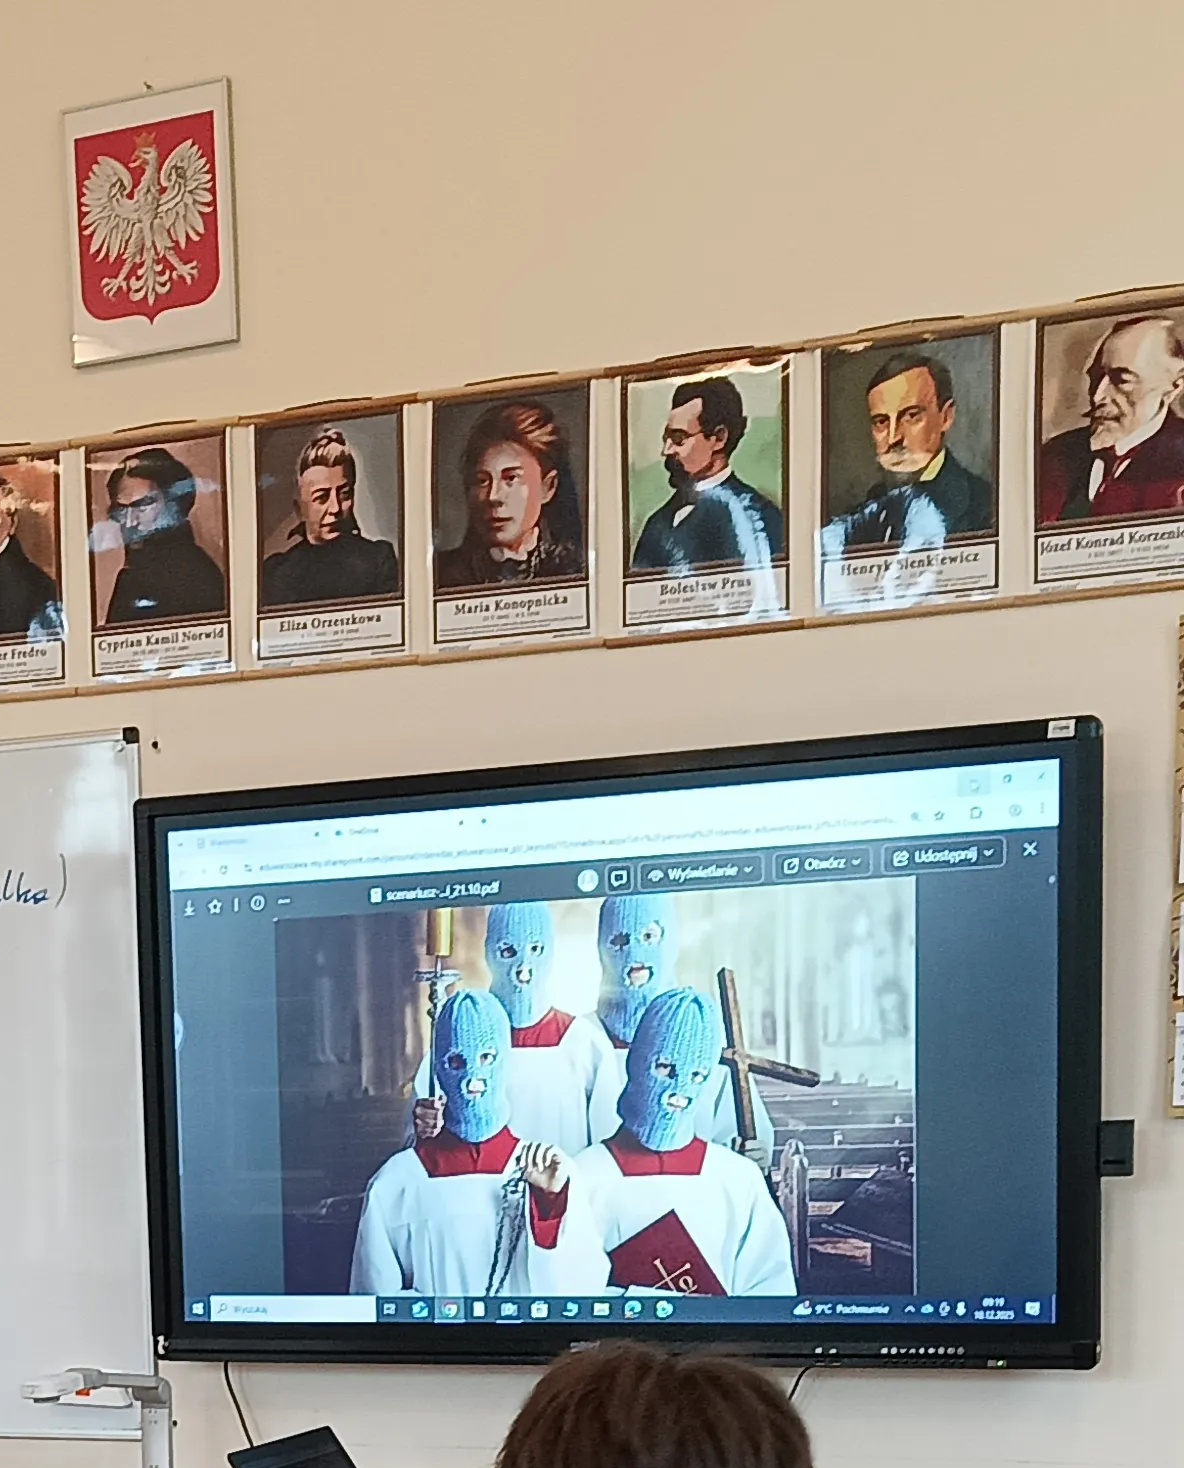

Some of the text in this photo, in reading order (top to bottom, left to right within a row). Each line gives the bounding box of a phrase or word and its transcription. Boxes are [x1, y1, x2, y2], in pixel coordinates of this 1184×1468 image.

[1040, 538, 1074, 556] Józef
[1075, 532, 1124, 550] Konrad
[840, 551, 980, 580] Henryk Sienkiewicz
[659, 577, 752, 597] Bolesław Prus
[454, 593, 568, 616] Maria Konopnicka
[279, 613, 382, 633] Eliza Orzeszkowa
[98, 627, 224, 653] Cyprian Kamil Norwid
[11, 647, 48, 661] Fredro
